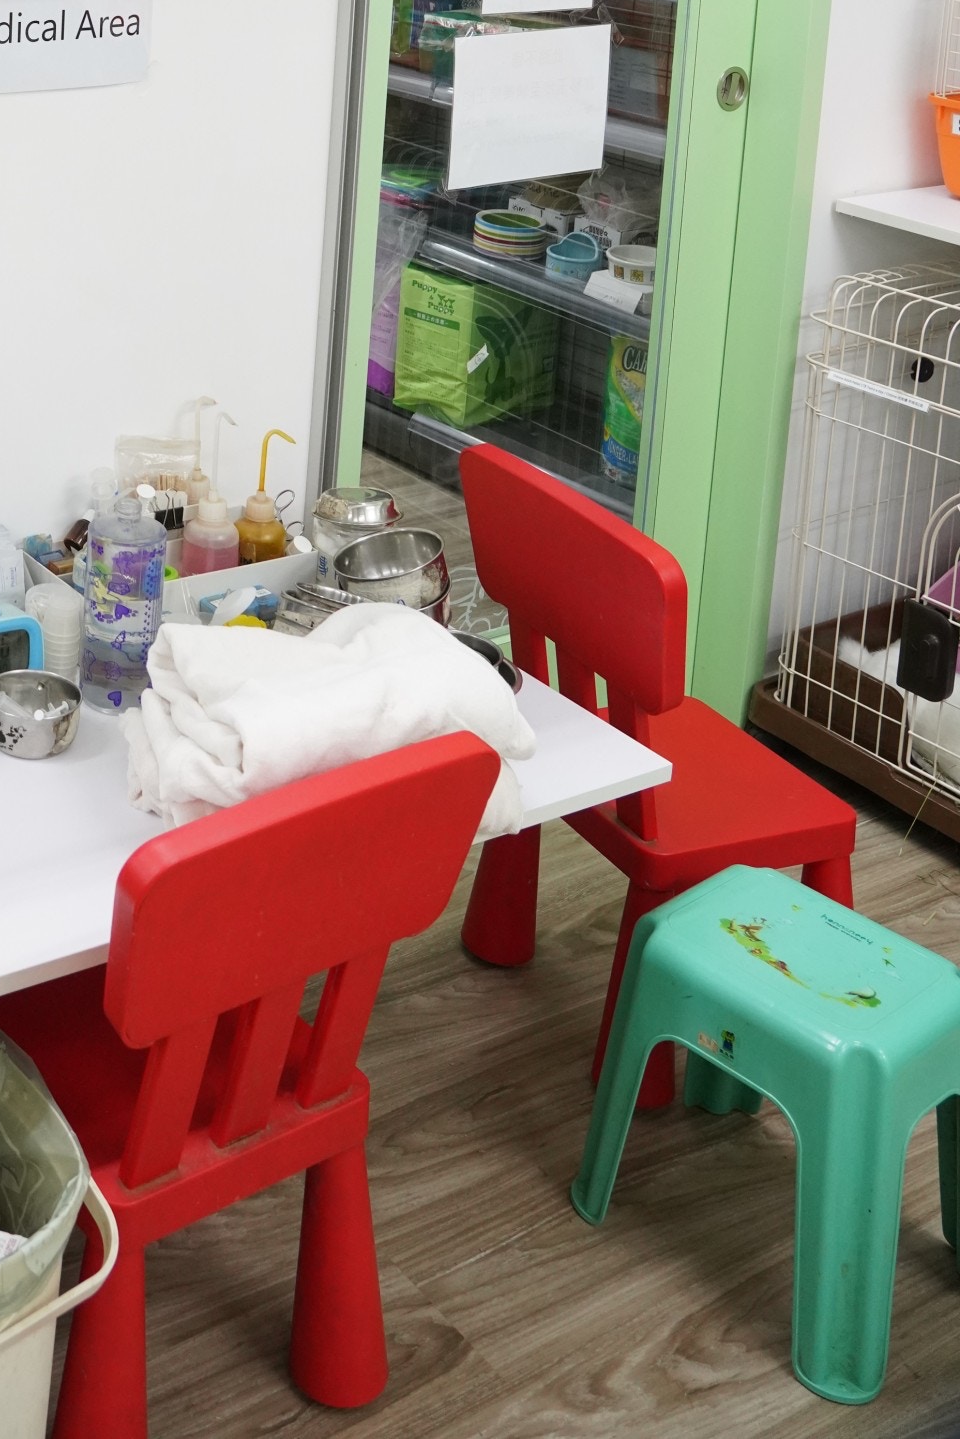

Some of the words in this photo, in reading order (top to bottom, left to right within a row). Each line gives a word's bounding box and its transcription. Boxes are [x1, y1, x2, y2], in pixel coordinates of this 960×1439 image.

[75, 9, 141, 40] Area
[411, 280, 437, 293] Puppy
[427, 301, 455, 315] Puppy
